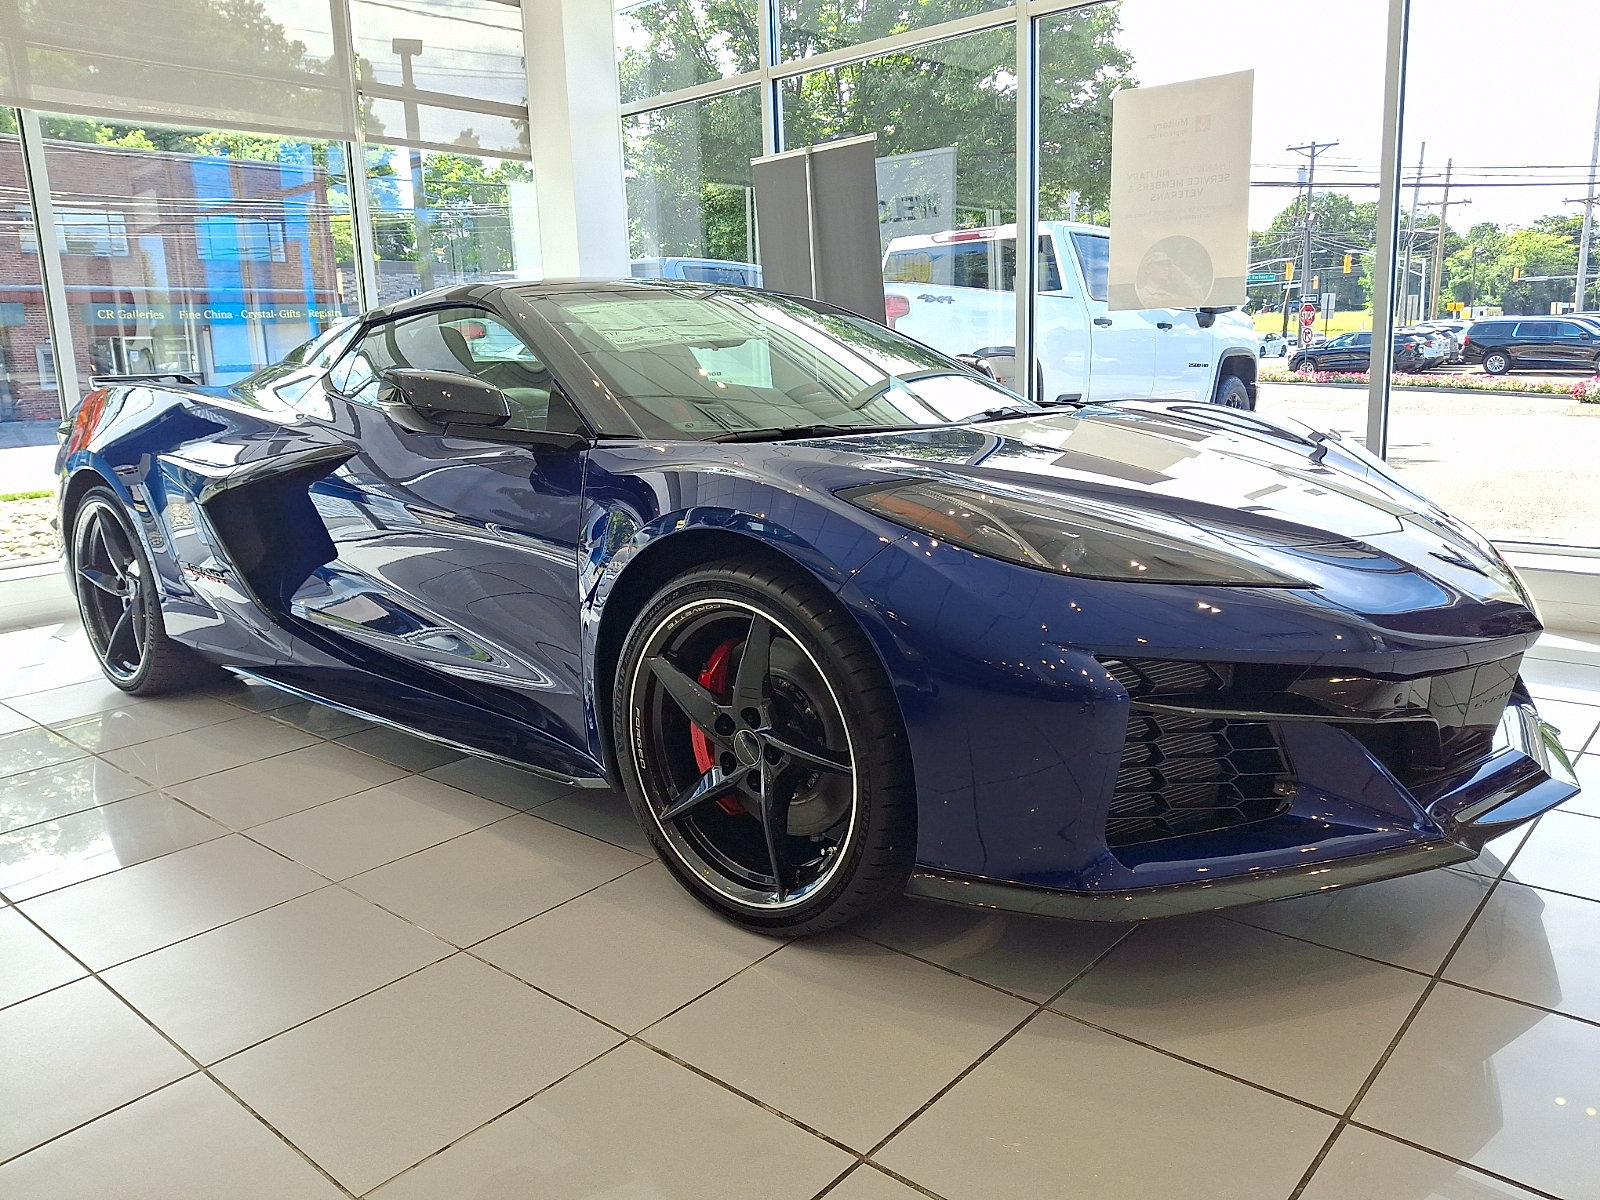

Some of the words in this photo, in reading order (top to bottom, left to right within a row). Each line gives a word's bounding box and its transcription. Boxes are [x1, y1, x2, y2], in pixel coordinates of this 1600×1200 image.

[97, 309, 115, 319] CR
[118, 309, 165, 320] Galleries
[179, 310, 201, 319] Fine
[203, 309, 233, 319] China
[279, 309, 301, 319] Gifts
[1301, 311, 1315, 320] STOP
[667, 604, 720, 631] CORVETTE
[635, 706, 647, 769] FORGED
